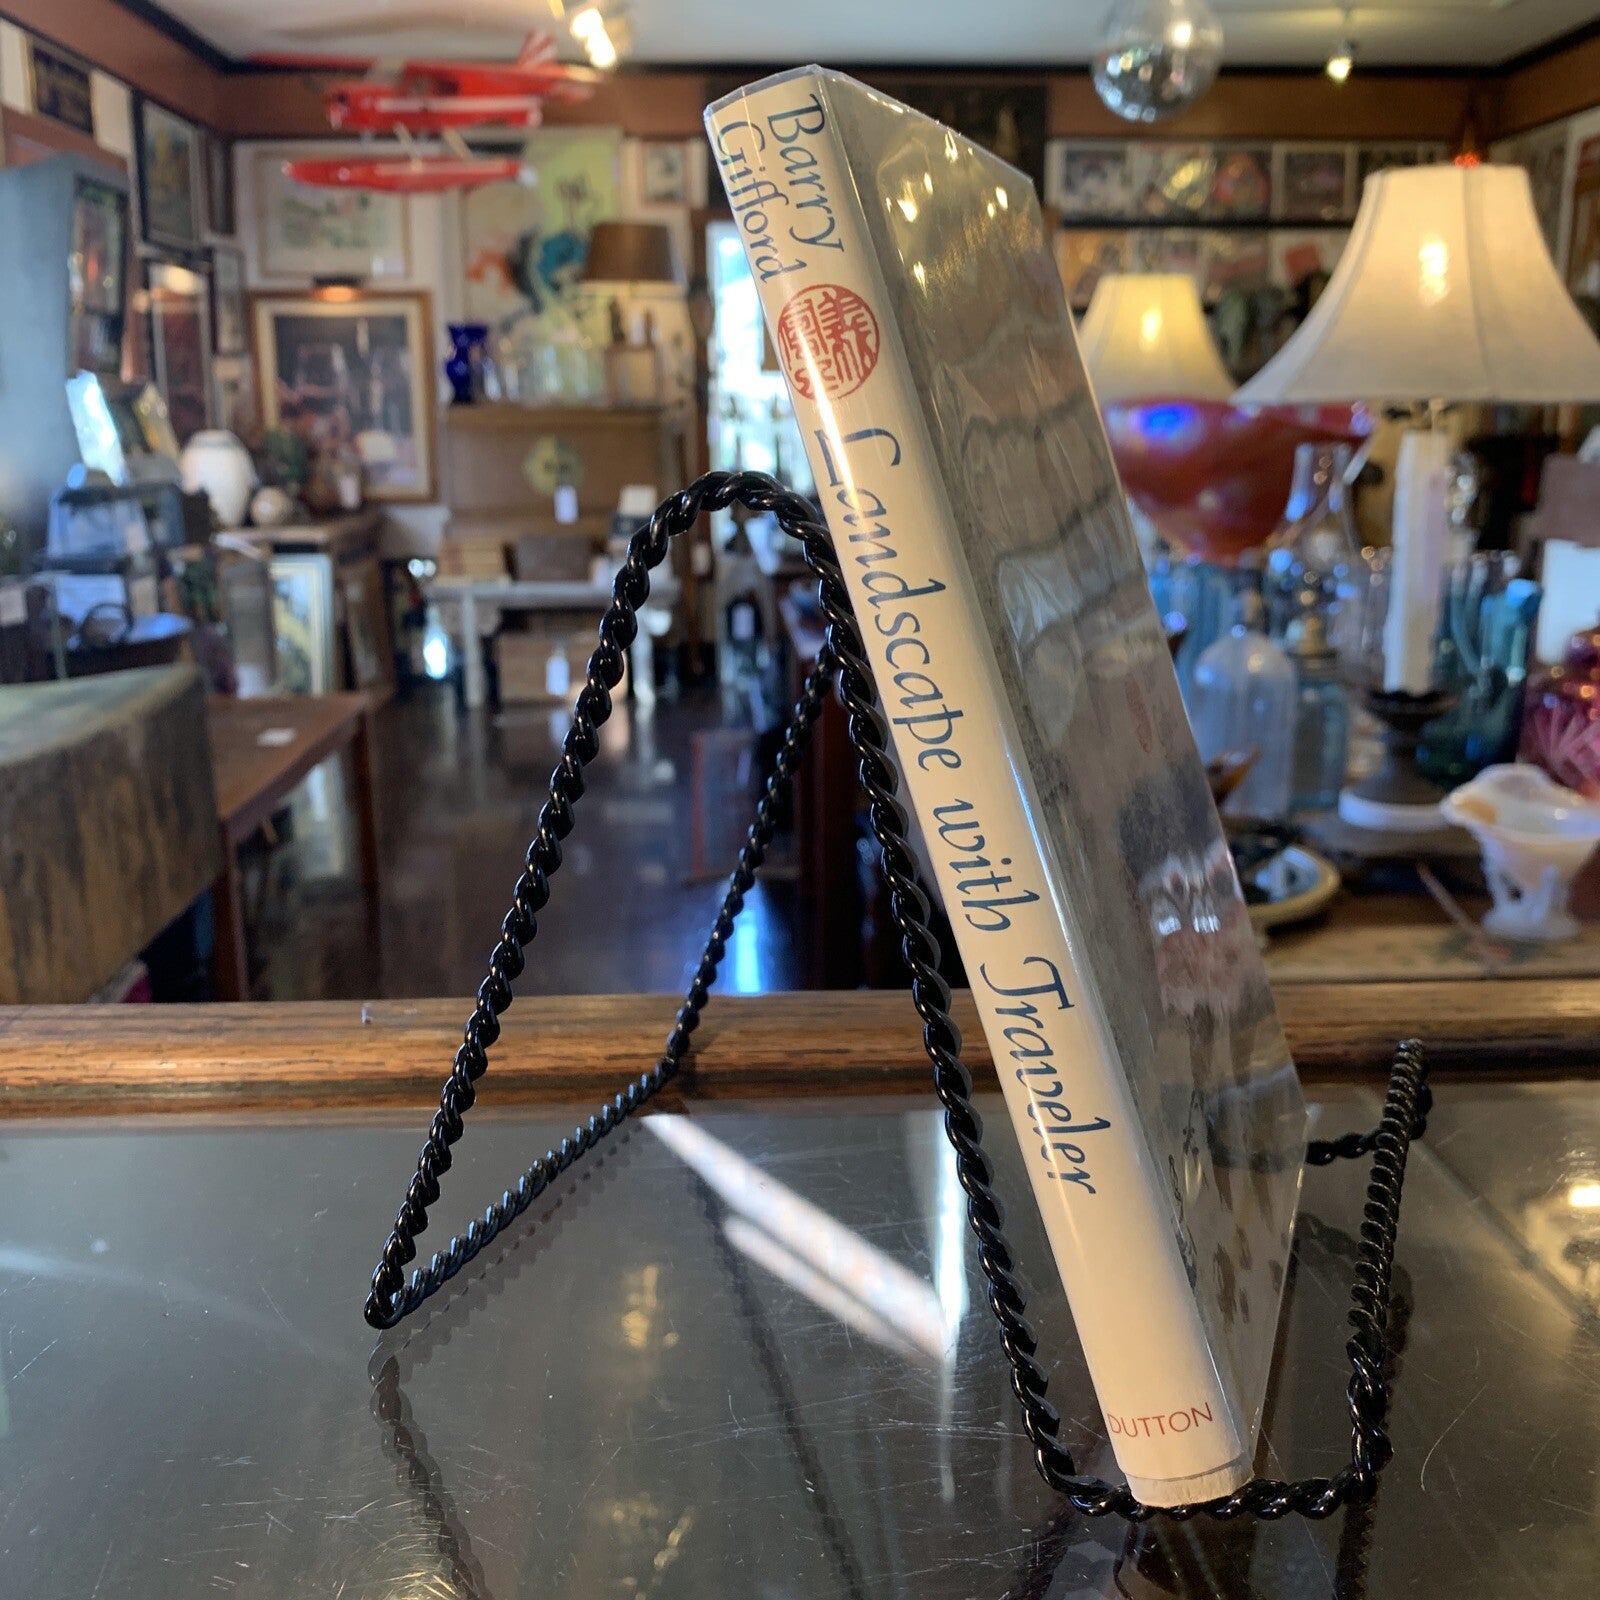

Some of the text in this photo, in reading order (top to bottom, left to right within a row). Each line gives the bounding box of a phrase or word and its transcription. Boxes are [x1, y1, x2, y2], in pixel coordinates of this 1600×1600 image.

[716, 120, 807, 284] Gifford
[767, 93, 844, 252] Barry
[814, 427, 964, 772] Landscape
[933, 798, 1040, 932] with
[979, 956, 1111, 1195] Traveler
[1106, 1402, 1213, 1438] DUTTON
